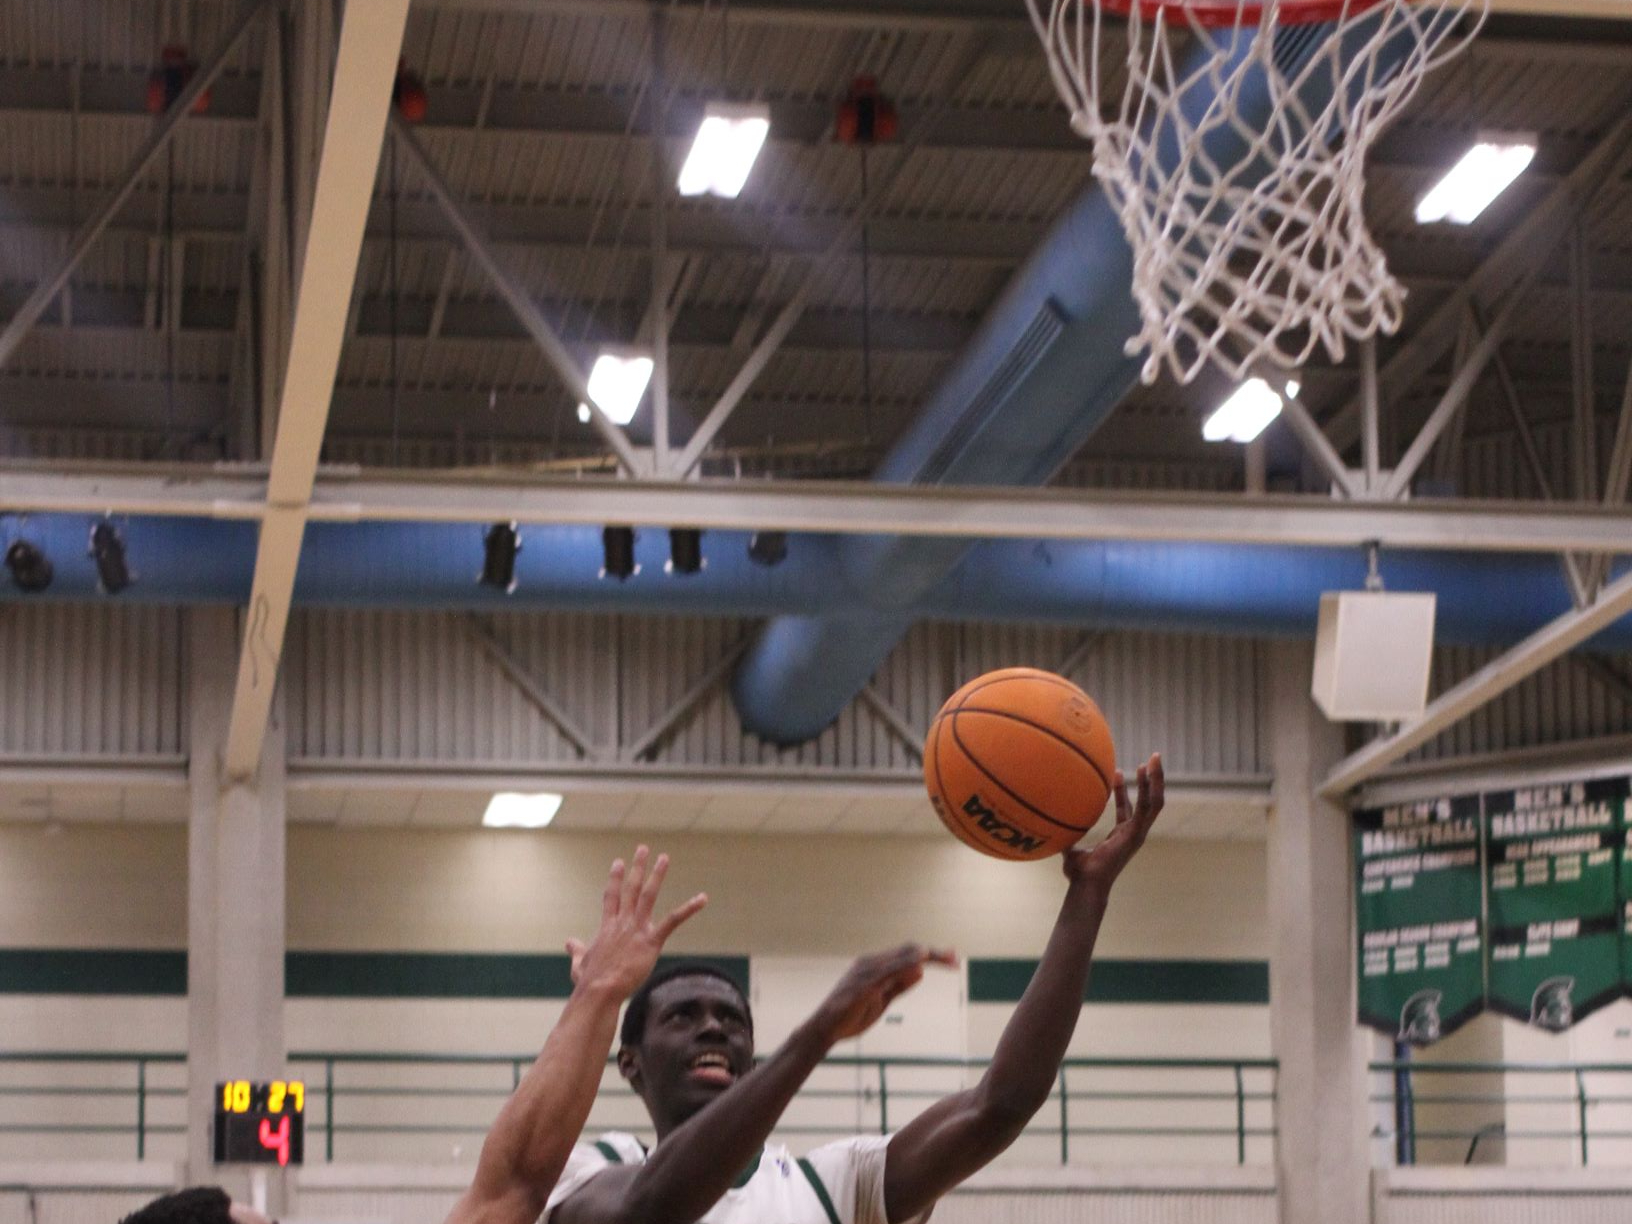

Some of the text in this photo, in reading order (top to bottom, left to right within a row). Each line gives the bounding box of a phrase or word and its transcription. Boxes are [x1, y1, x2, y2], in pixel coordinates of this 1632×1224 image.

[1362, 818, 1476, 857] BASKETBALL
[1492, 803, 1611, 839] BASKETBALL
[259, 1115, 289, 1167] 4
